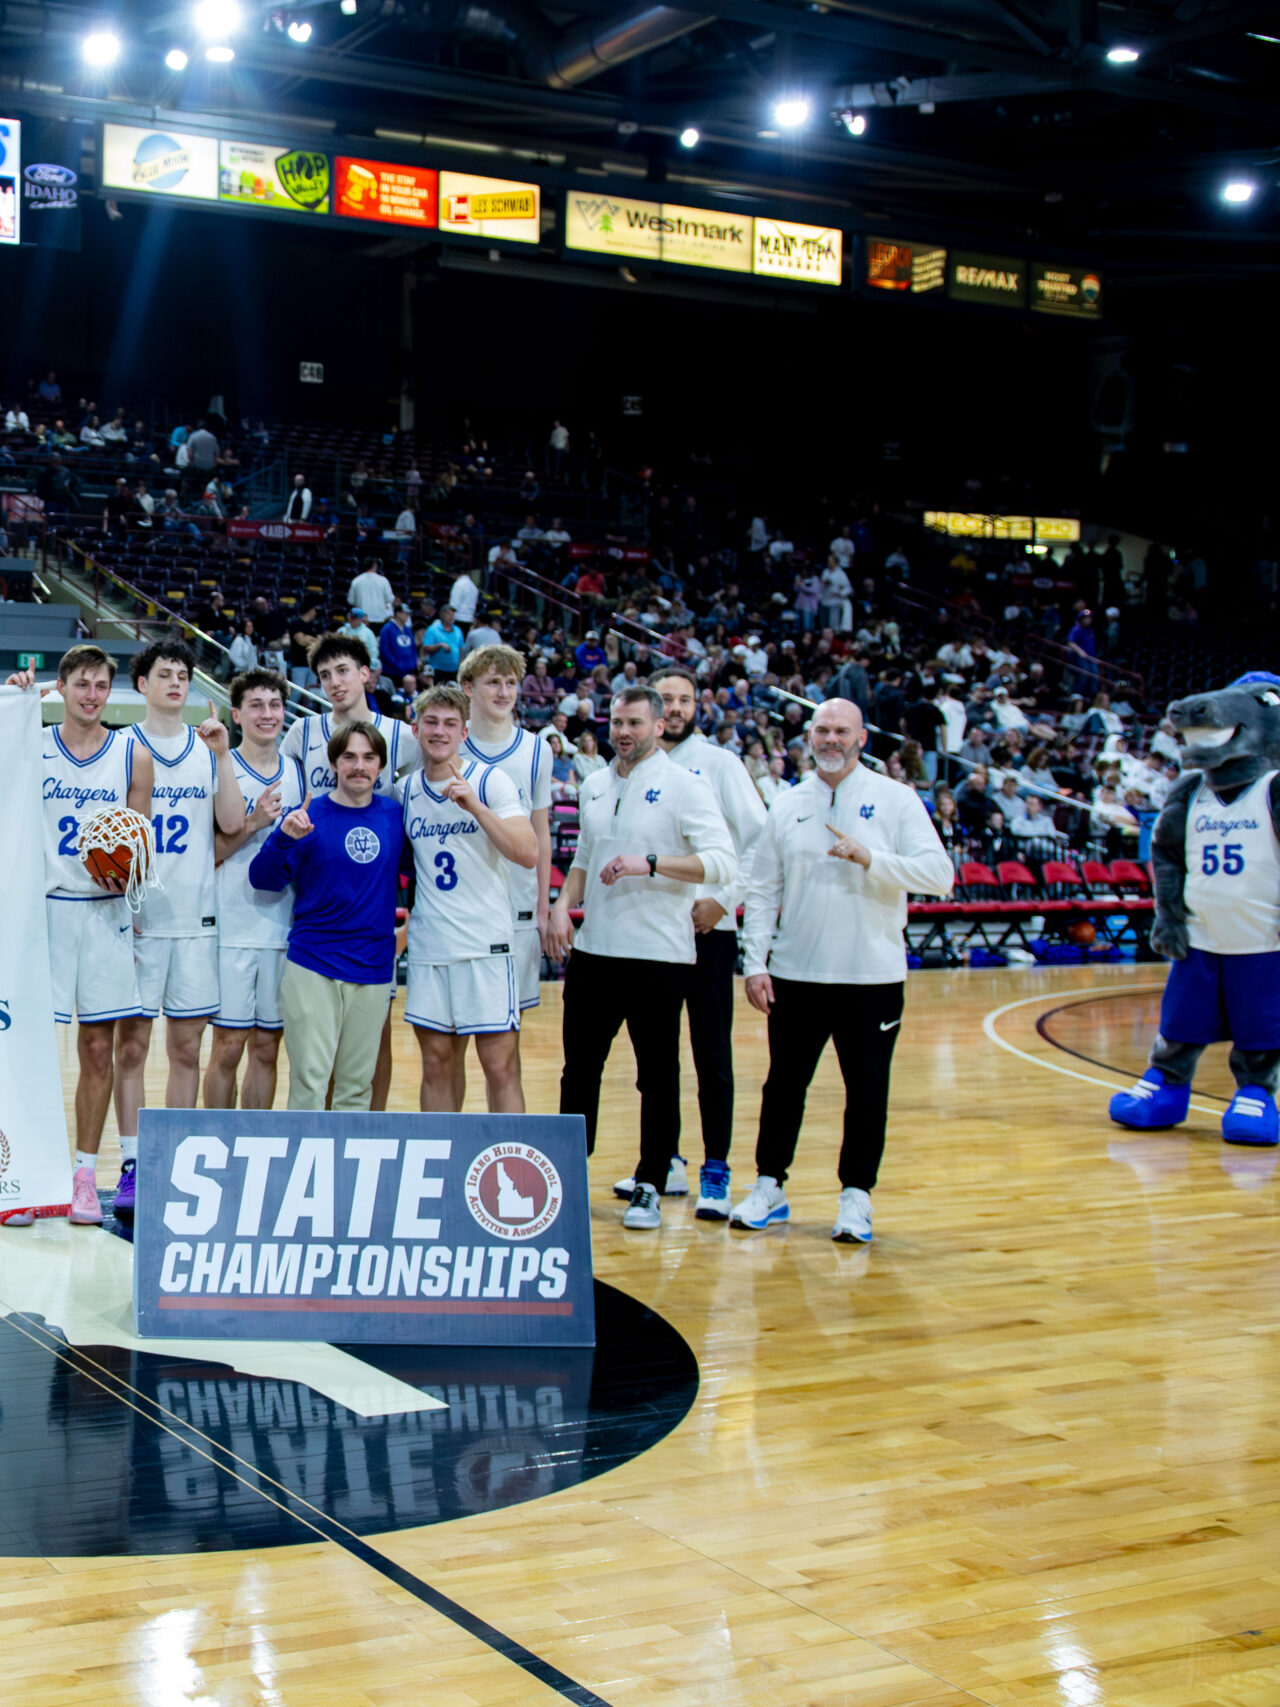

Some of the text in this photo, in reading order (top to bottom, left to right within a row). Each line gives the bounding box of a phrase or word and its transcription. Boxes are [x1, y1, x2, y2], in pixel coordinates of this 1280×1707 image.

[25, 181, 77, 201] IDAHO
[626, 209, 744, 244] Westmark
[956, 265, 1020, 292] RE/MAX
[42, 777, 119, 808] Chargers
[152, 814, 190, 855] 12
[409, 817, 479, 845] Chargers
[1195, 813, 1260, 838] Chargers
[434, 851, 458, 891] 3
[1201, 843, 1245, 876] 55
[163, 1135, 452, 1239] STATE
[159, 1241, 570, 1299] CHAMPIONSHIPS
